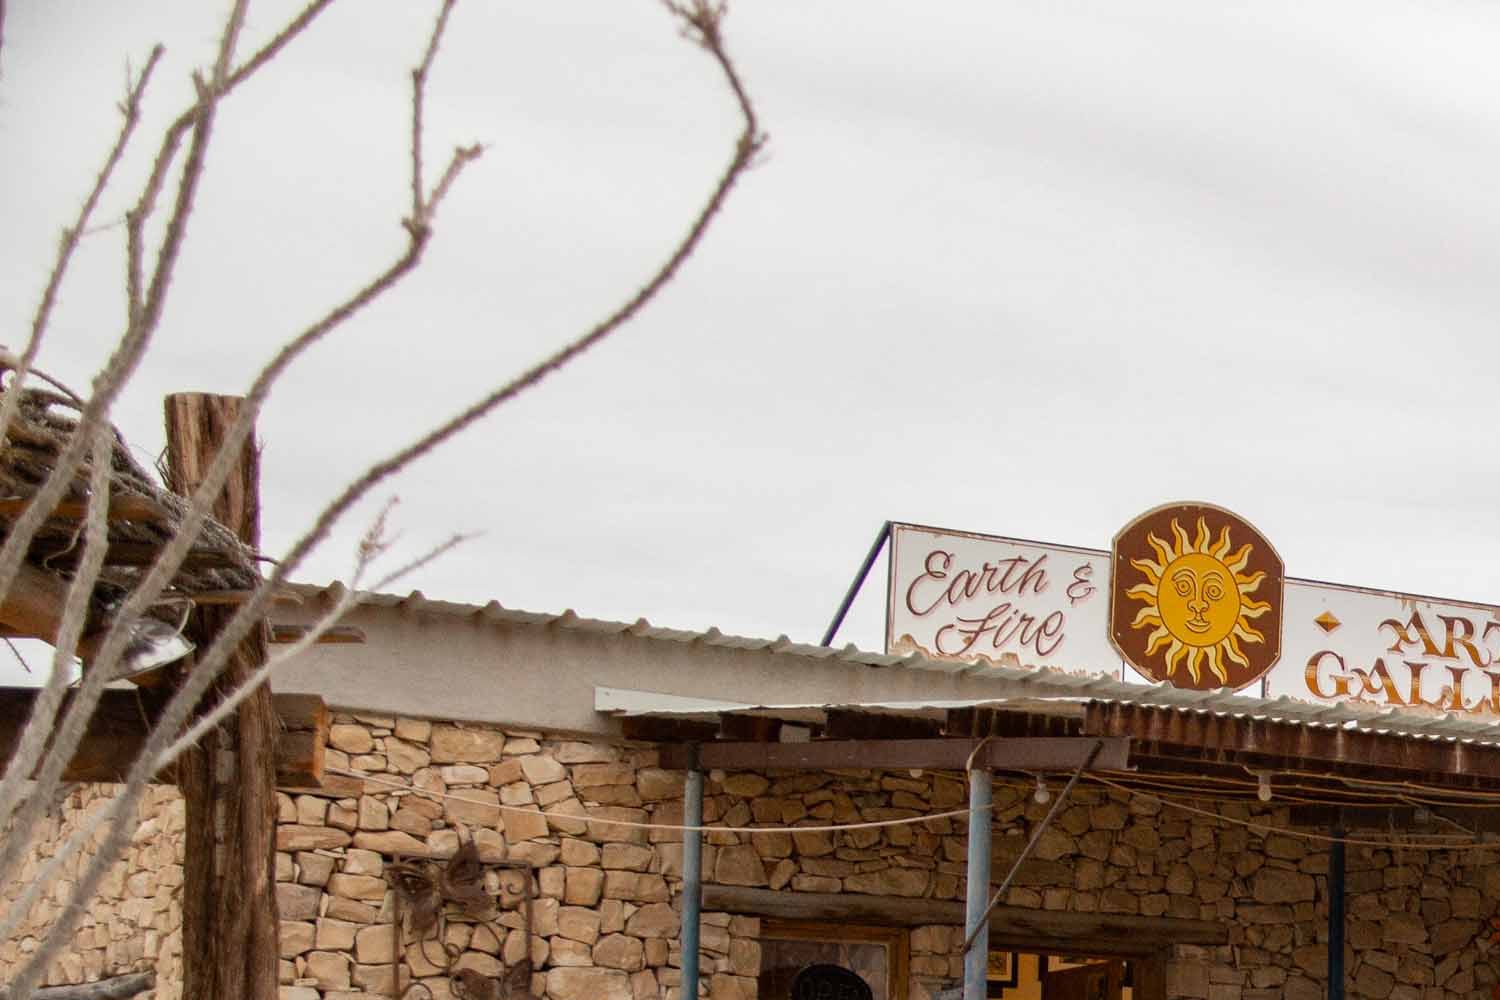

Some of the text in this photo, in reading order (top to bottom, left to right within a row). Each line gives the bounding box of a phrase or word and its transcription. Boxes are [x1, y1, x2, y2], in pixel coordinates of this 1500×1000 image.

[906, 550, 1096, 616] Earth &
[935, 602, 1065, 656] Fire
